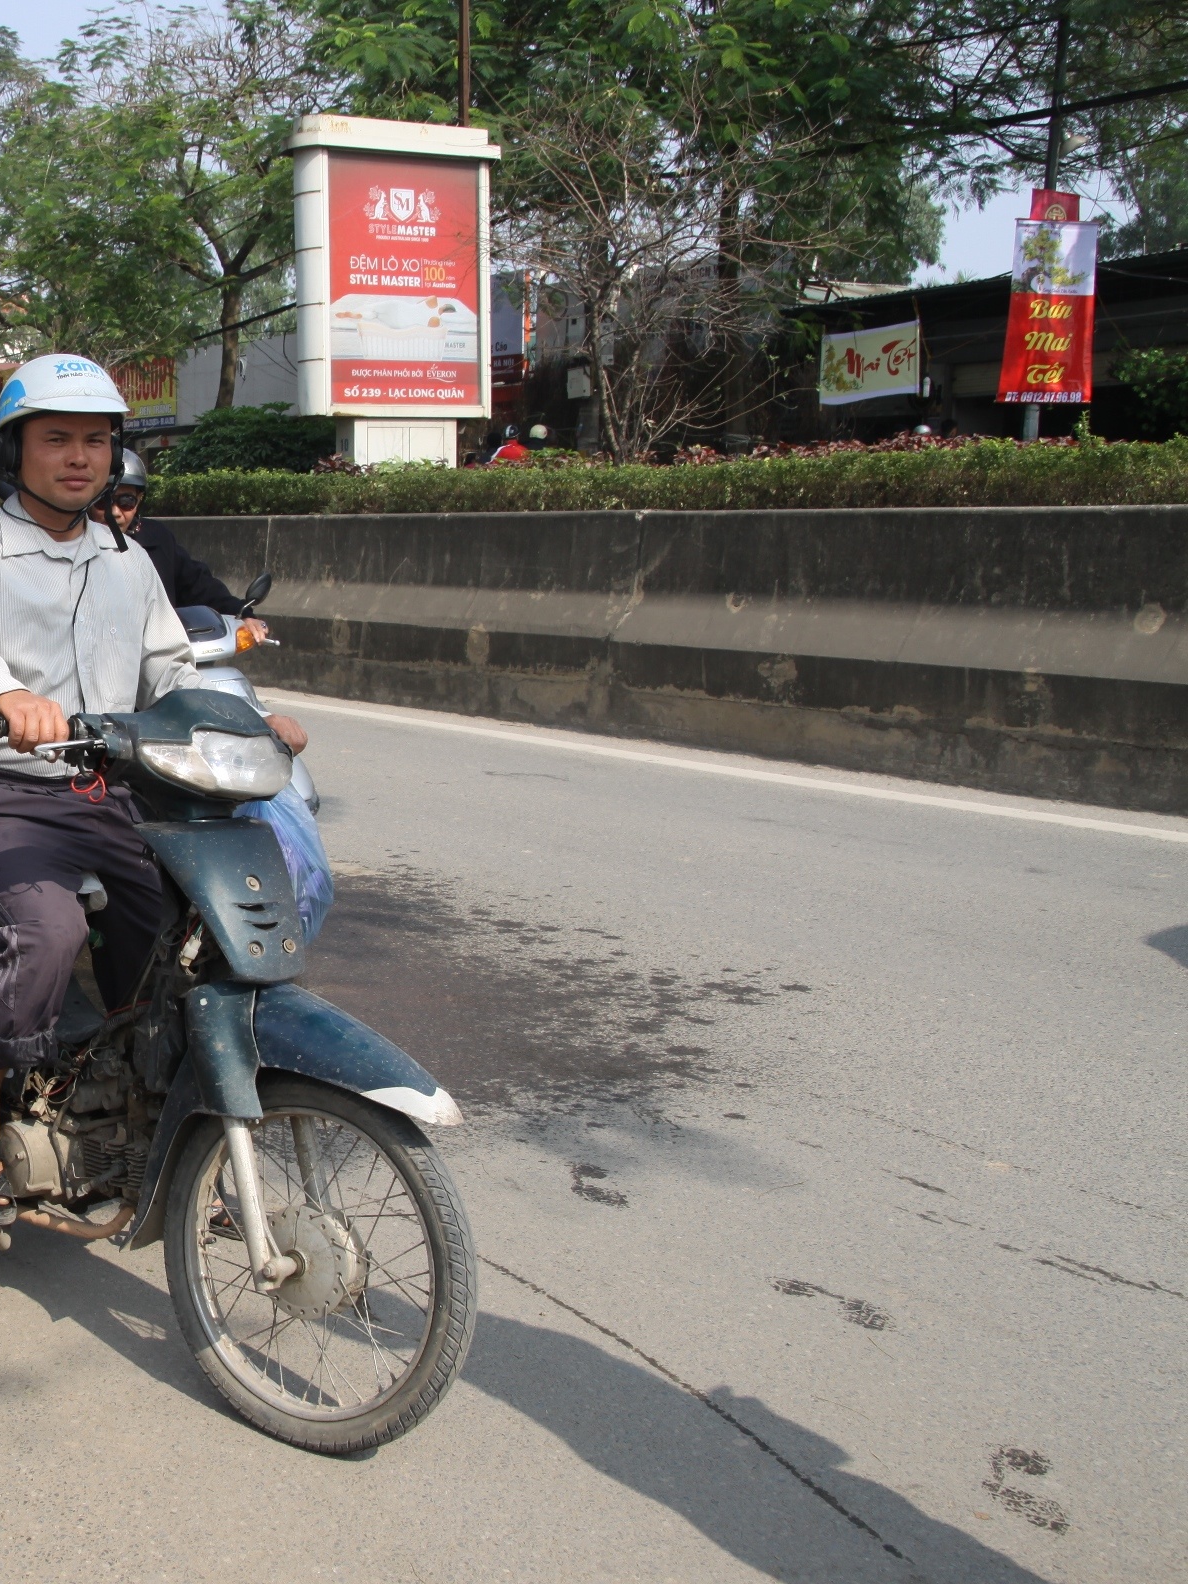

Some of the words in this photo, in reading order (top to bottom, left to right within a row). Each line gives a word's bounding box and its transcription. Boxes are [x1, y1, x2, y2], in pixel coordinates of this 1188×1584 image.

[350, 254, 378, 272] ĐỆM
[402, 259, 420, 272] XO
[349, 274, 378, 285] STYLE
[381, 275, 421, 287] MASTER
[424, 267, 445, 281] 100
[1028, 299, 1073, 319] Bán
[1025, 331, 1073, 353] Mai
[53, 362, 105, 377] xanh
[351, 368, 372, 378] ĐƯỢC
[426, 370, 457, 378] EVERON
[845, 348, 880, 383] Mai
[1026, 362, 1065, 384] Tết
[344, 384, 359, 397] SỐ
[361, 387, 381, 397] 239
[388, 388, 407, 399] LẠC
[408, 388, 435, 398] LONG
[436, 387, 464, 399] QUÂN
